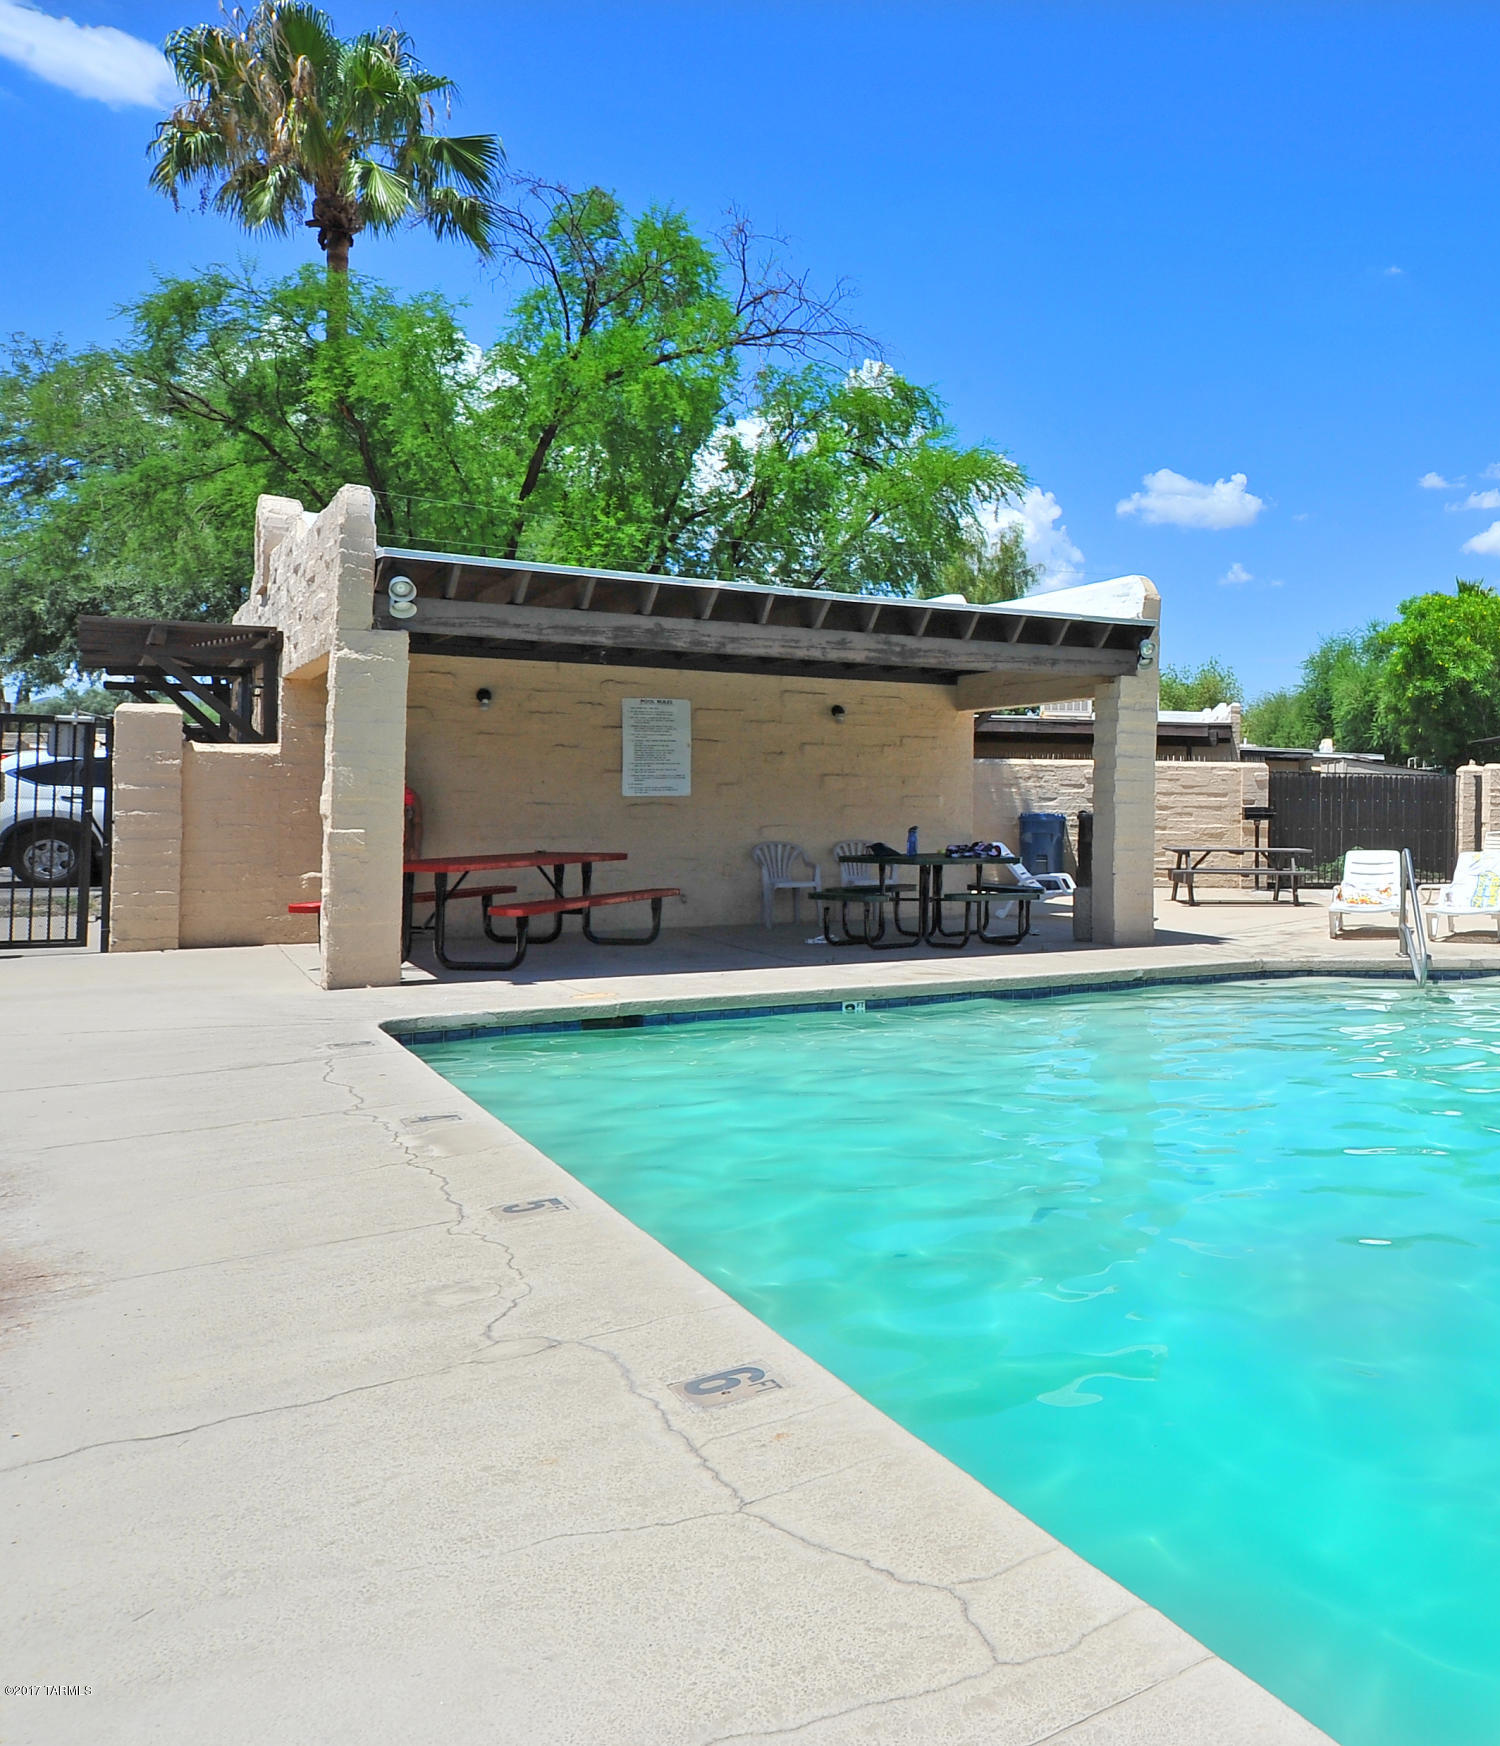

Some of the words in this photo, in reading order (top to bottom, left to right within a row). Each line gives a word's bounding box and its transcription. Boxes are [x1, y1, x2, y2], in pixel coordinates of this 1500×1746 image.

[502, 1197, 564, 1214] 5
[683, 1366, 766, 1396] 6
[748, 1379, 784, 1394] FT
